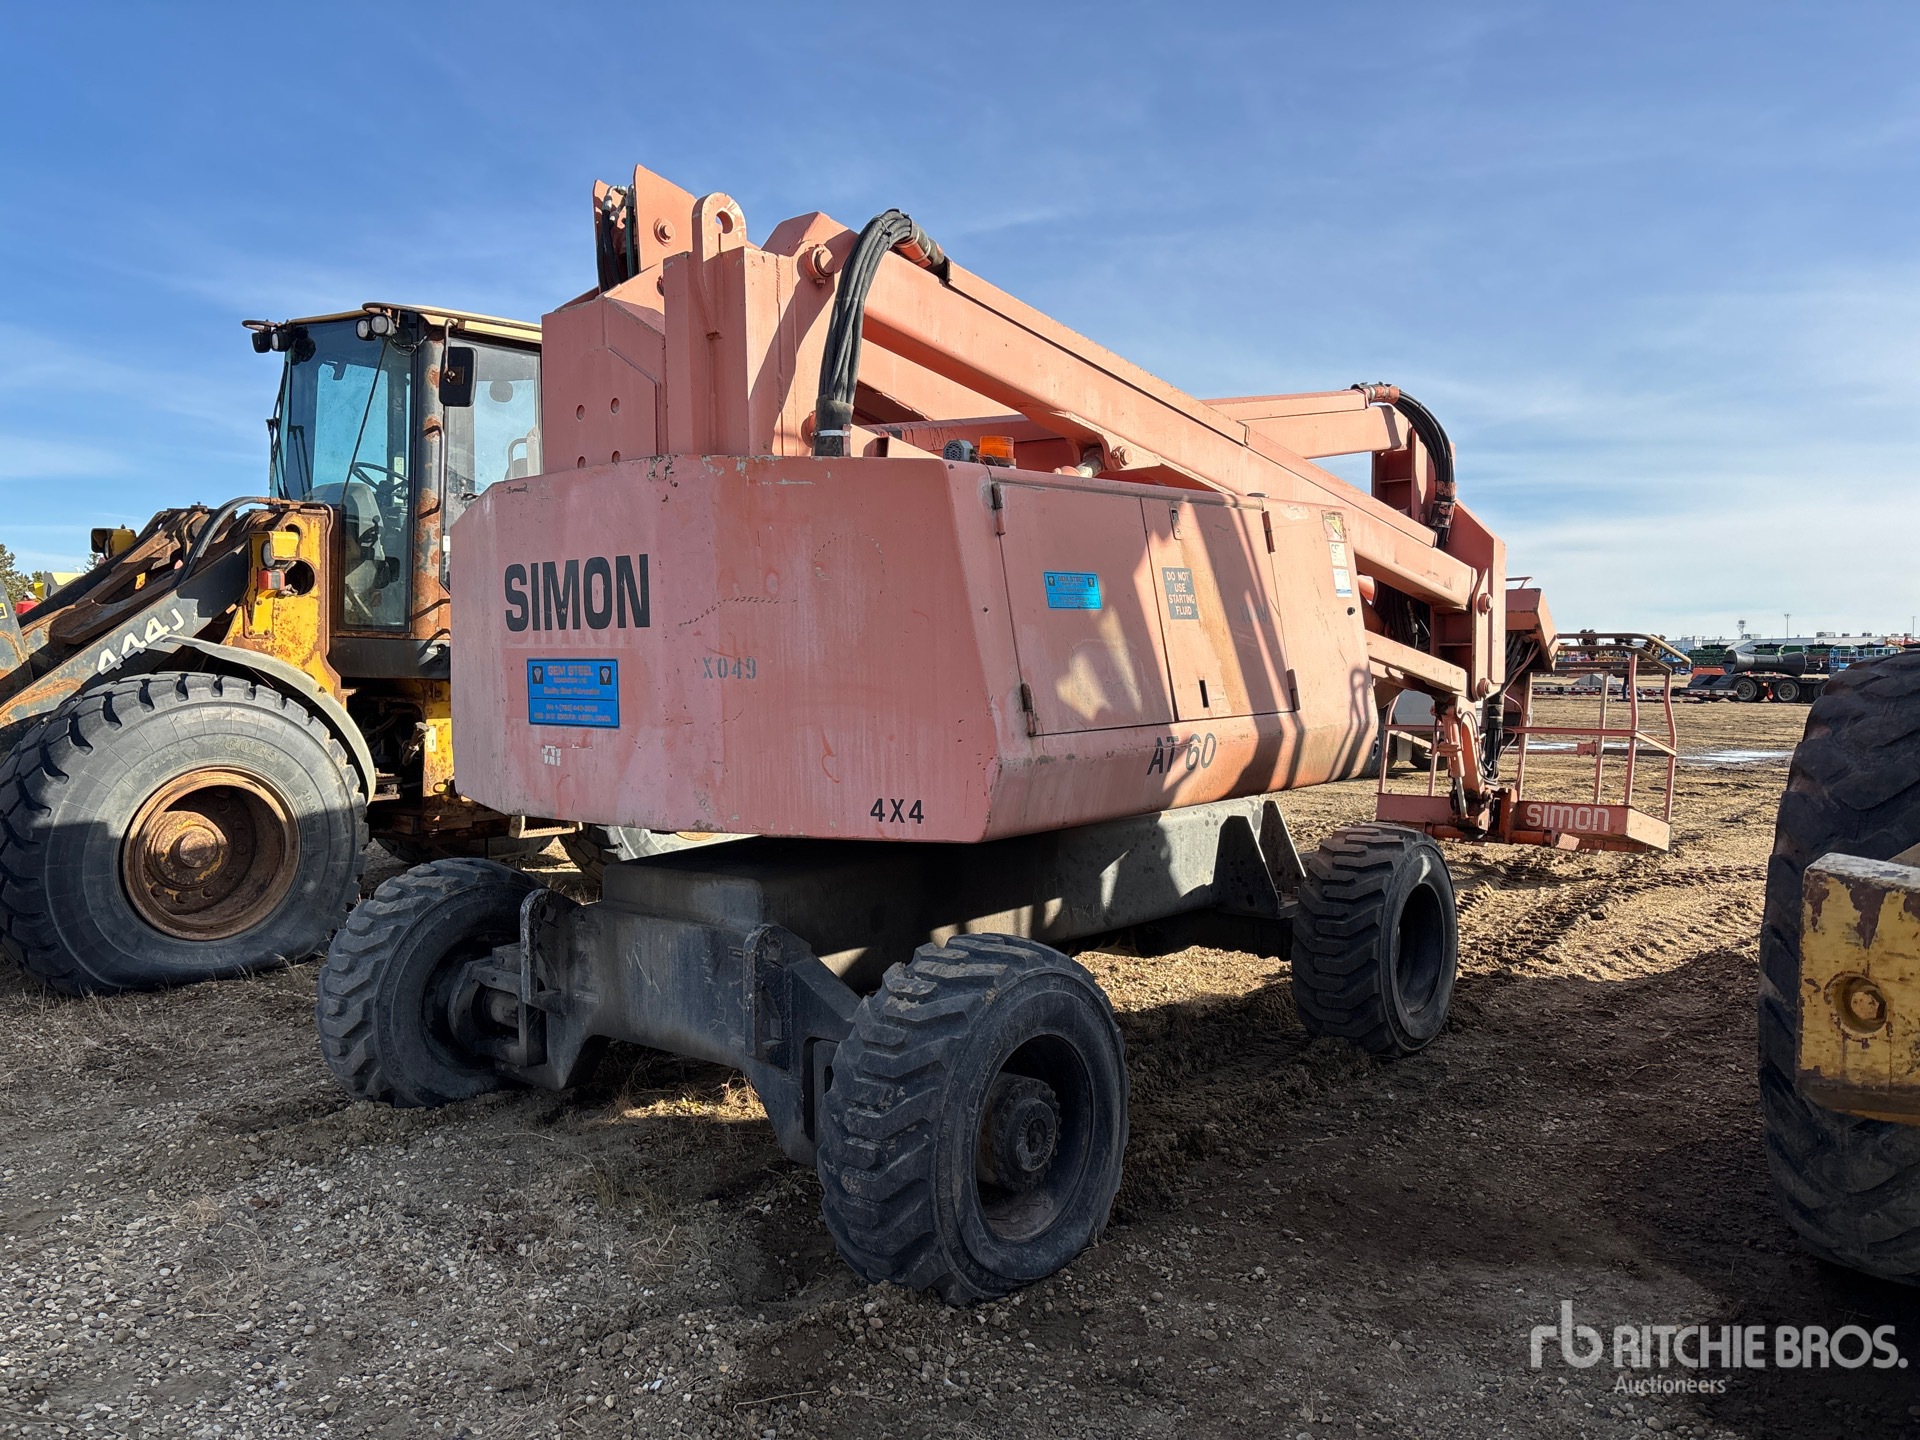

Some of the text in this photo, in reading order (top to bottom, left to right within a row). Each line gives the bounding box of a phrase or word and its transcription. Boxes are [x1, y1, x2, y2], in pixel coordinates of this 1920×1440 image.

[1166, 571, 1190, 581] DO NOT
[1174, 582, 1187, 593] USE
[504, 553, 651, 632] SIMON
[1168, 594, 1196, 604] STARTING
[1175, 605, 1193, 616] FLUID
[97, 608, 185, 676] 444J
[701, 655, 758, 681] X049
[1147, 732, 1217, 776] AT 60
[869, 797, 925, 825] 4X4
